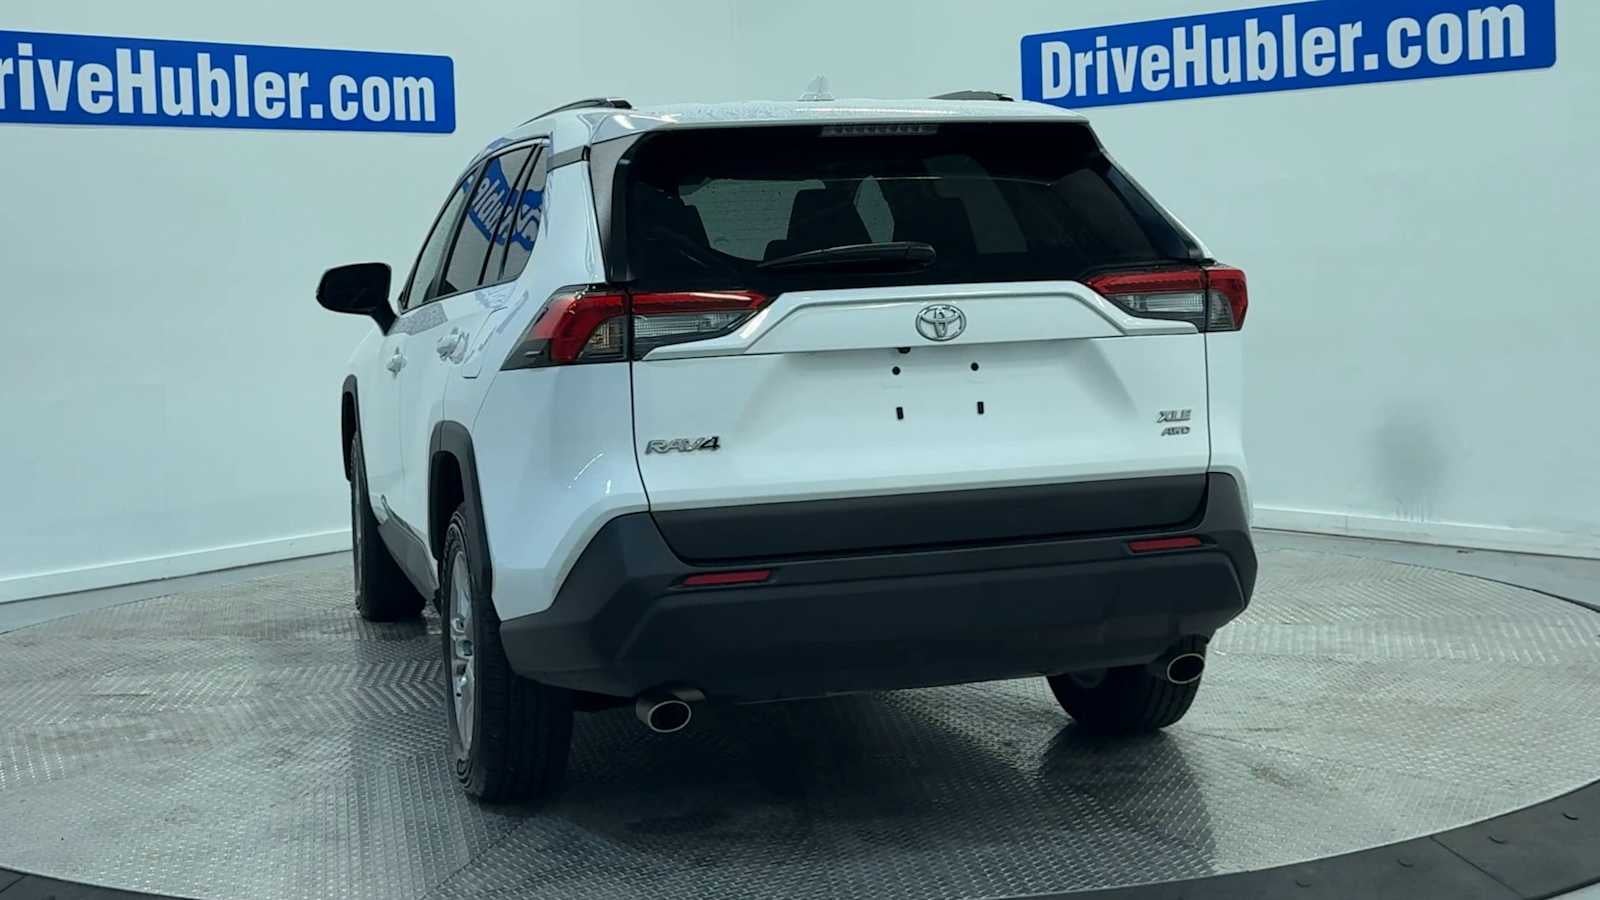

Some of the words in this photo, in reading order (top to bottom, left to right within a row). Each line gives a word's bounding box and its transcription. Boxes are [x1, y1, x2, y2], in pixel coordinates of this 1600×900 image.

[1040, 3, 1526, 100] DriveHubler.com
[1156, 409, 1192, 424] XLE
[645, 435, 720, 455] RAV4
